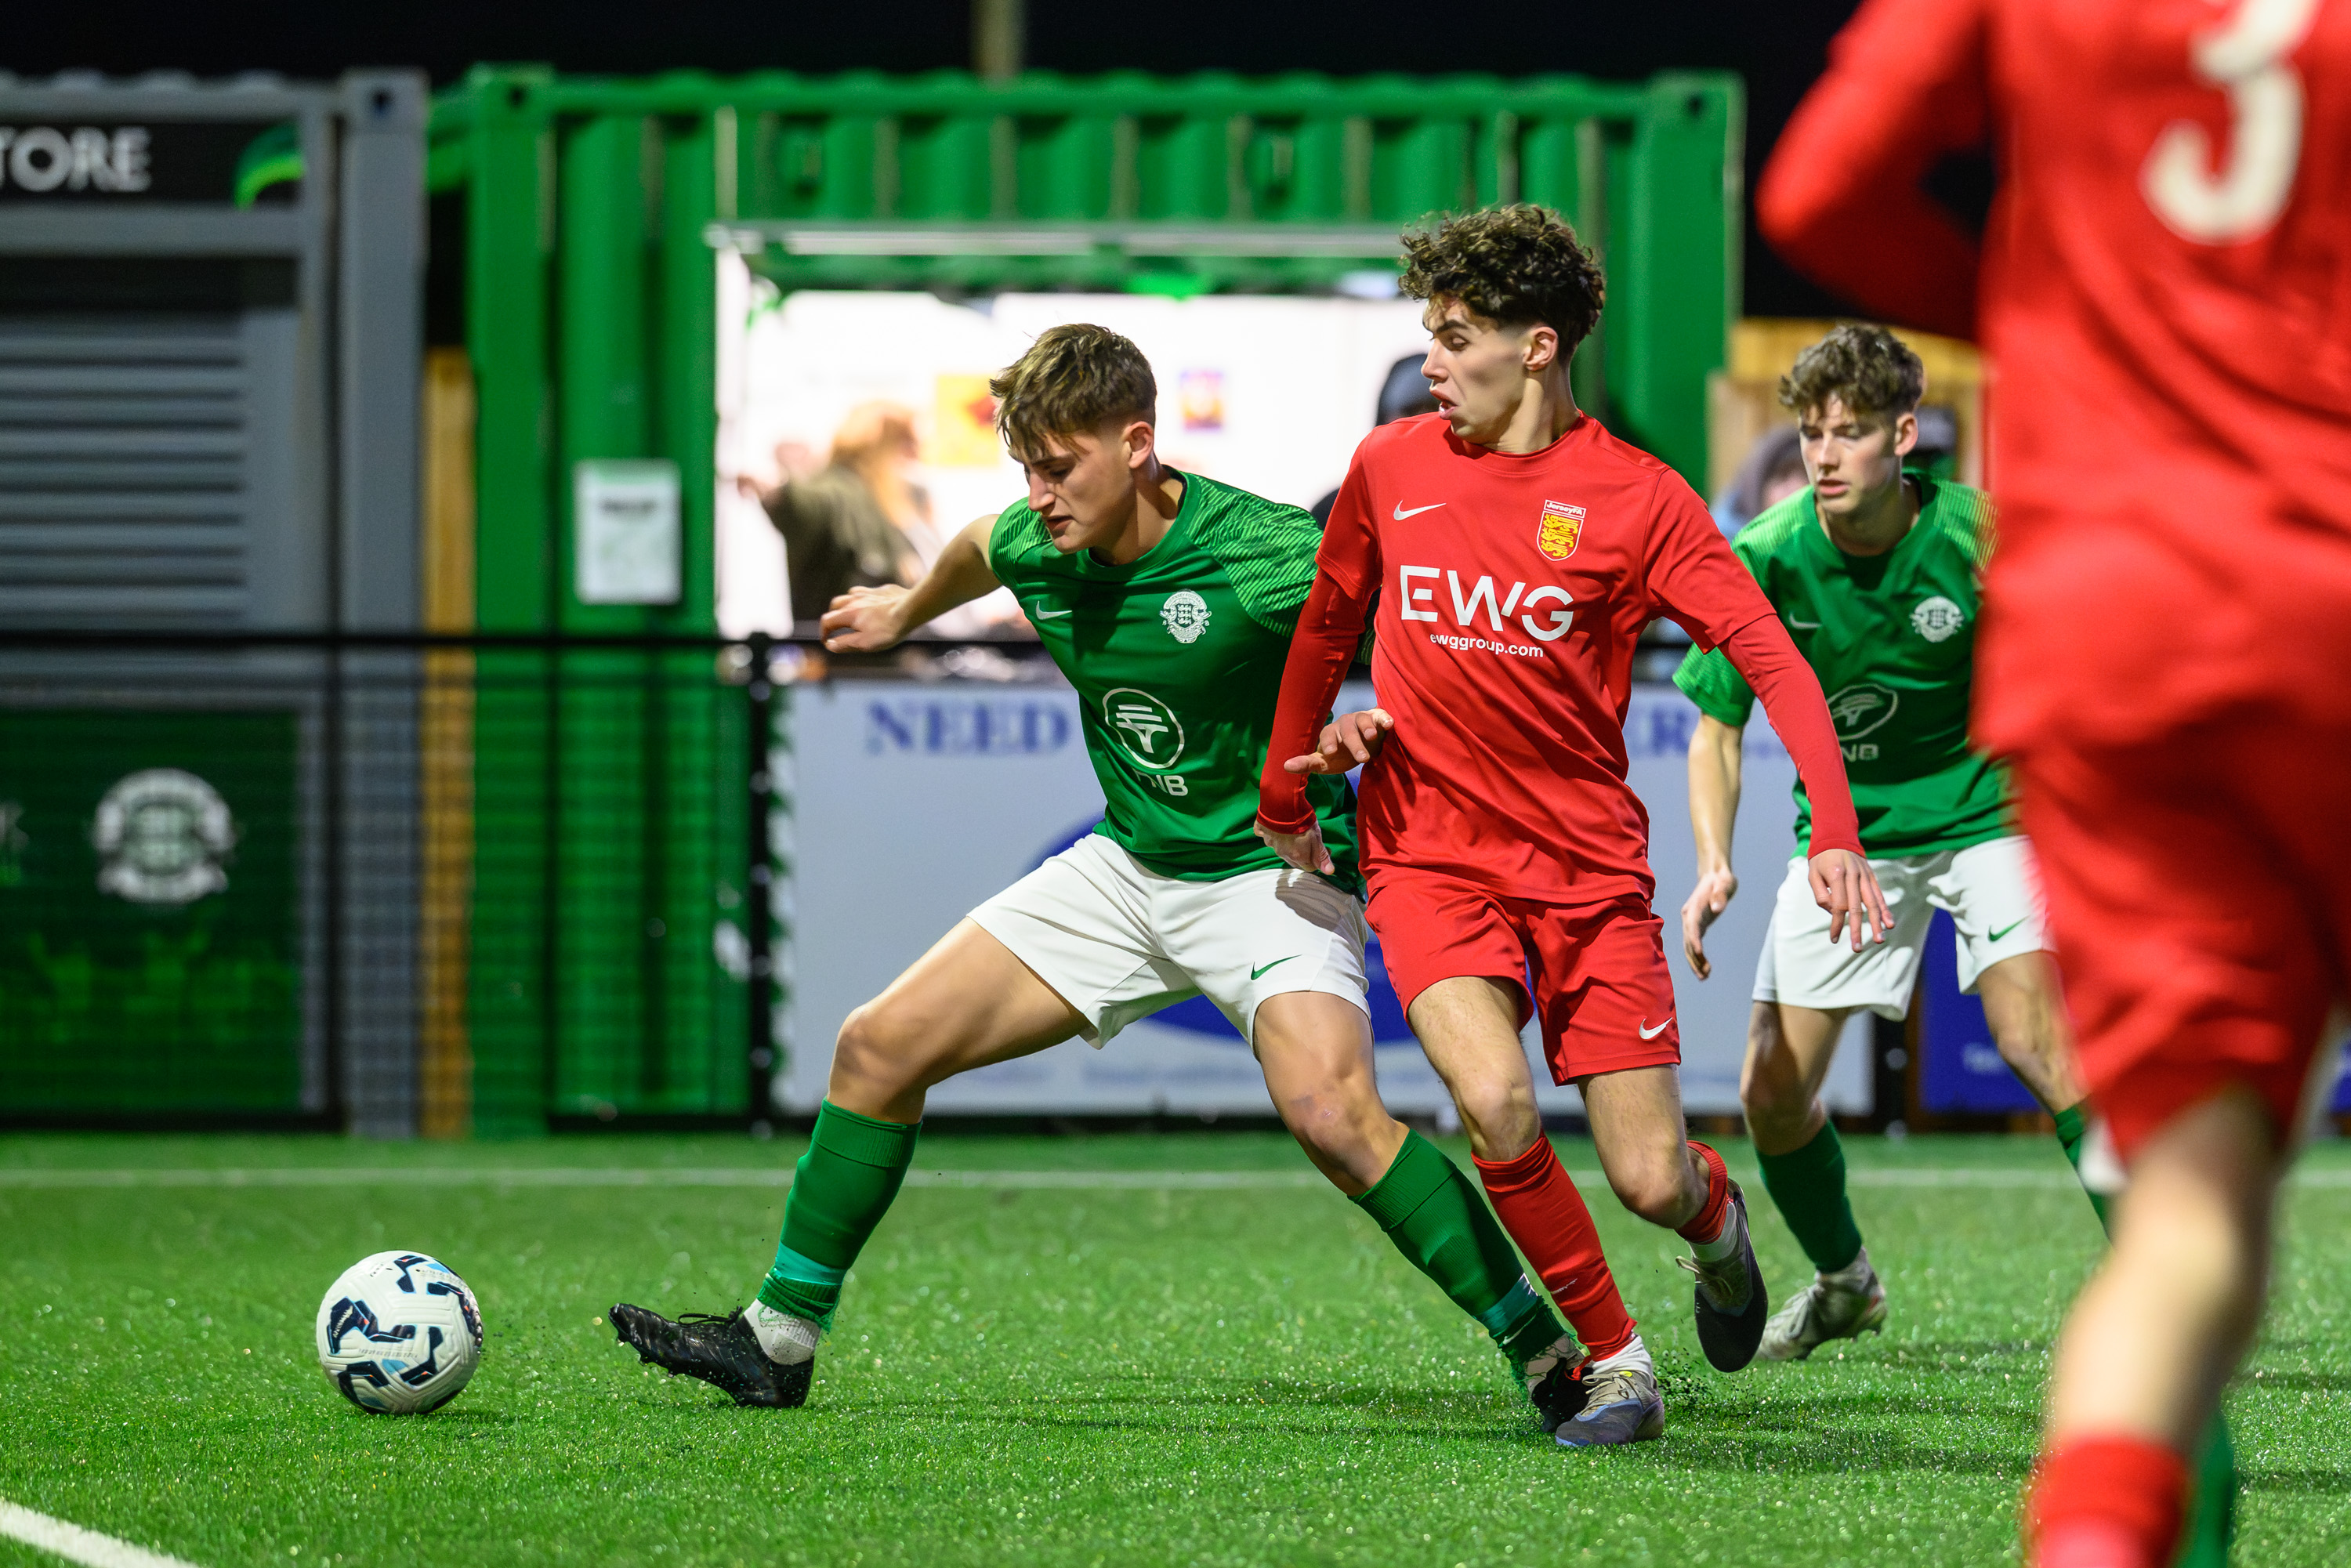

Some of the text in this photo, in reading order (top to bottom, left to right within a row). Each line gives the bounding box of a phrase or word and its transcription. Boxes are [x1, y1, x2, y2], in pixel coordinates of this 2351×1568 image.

[2146, 0, 2320, 240] 3
[1546, 502, 1583, 516] JerseyFA
[1400, 564, 1574, 642] EWG
[1429, 632, 1545, 657] ewggroup.com
[864, 700, 1071, 755] NEED
